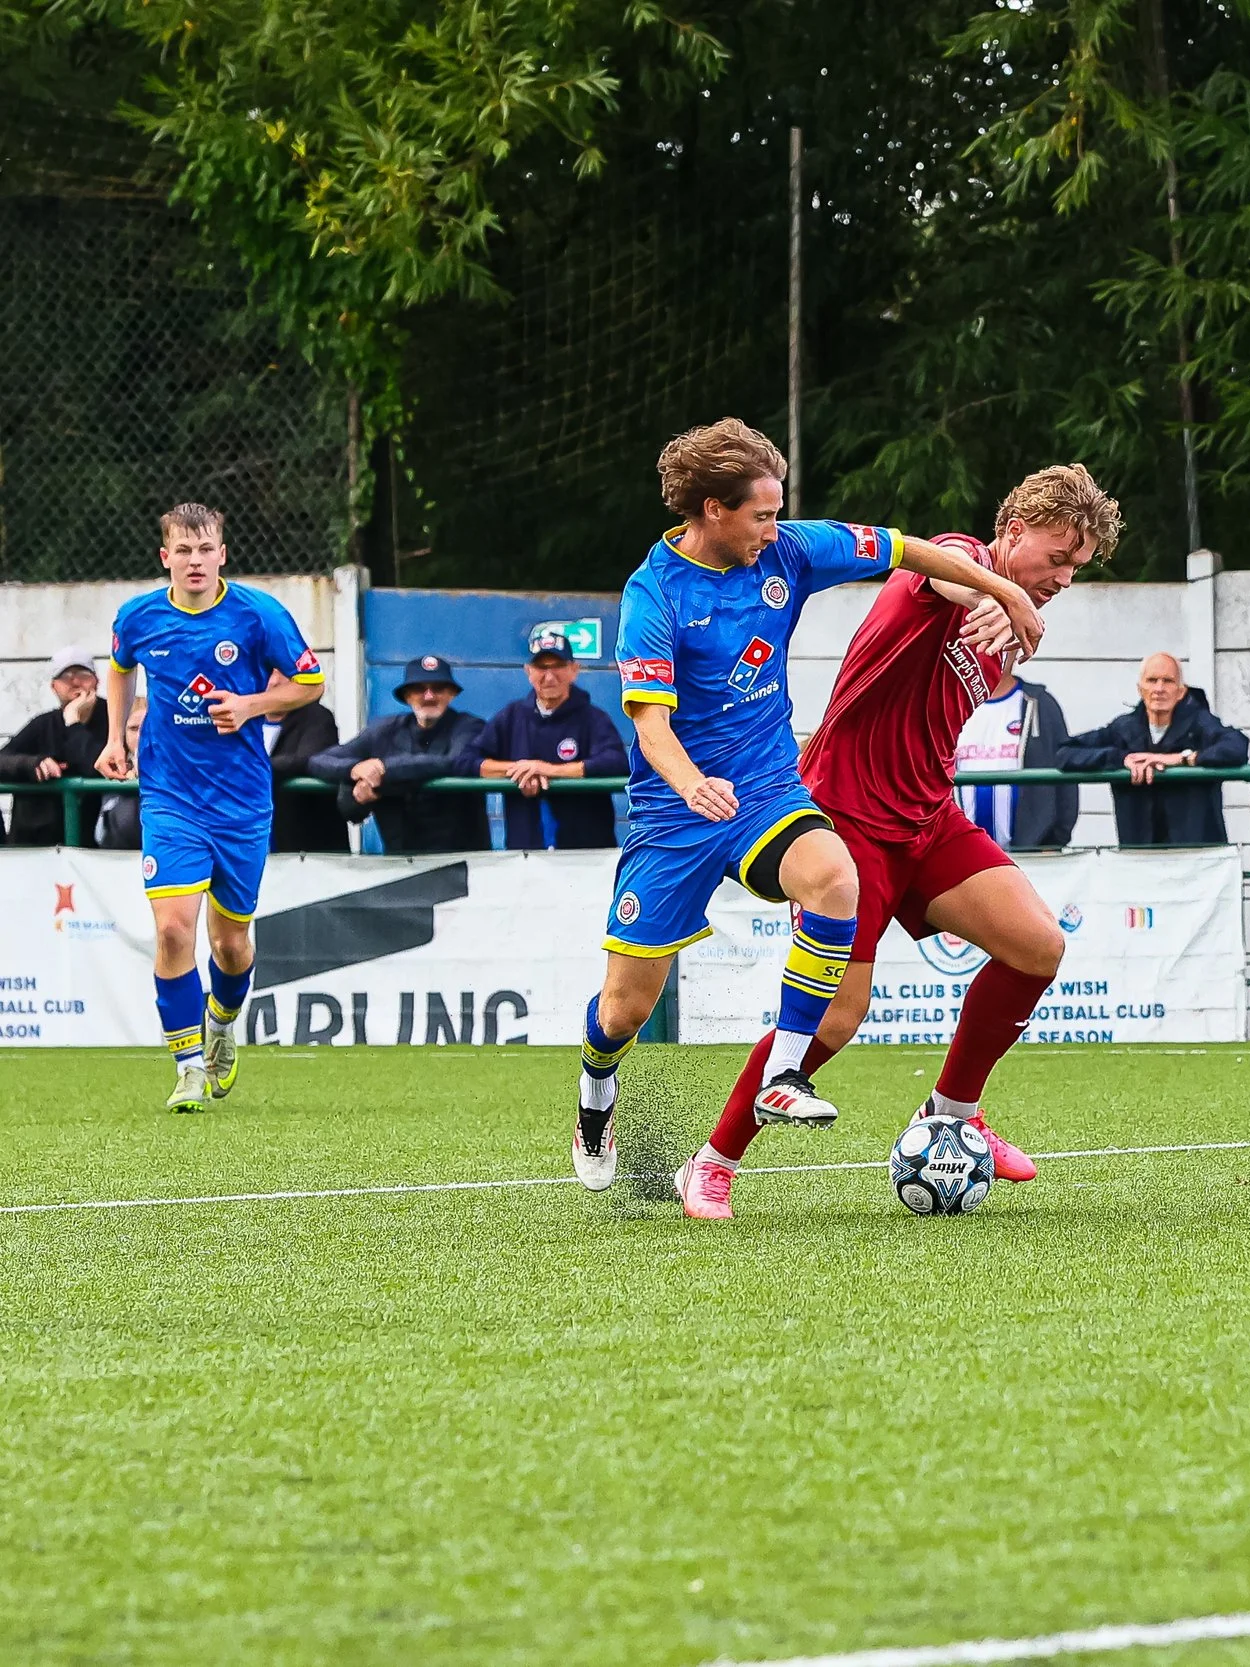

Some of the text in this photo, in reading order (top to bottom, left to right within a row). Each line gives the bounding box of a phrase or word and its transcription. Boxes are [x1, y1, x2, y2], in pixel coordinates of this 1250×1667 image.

[946, 638, 986, 706] Simply Bathr
[173, 713, 212, 725] Domin
[752, 918, 790, 936] Rota
[822, 966, 845, 978] SC
[871, 985, 893, 999] AL
[899, 984, 945, 999] CLUB
[1060, 981, 1108, 996] WISH
[44, 1000, 85, 1014] CLUB
[1030, 1003, 1165, 1020] OTBALL CLUB
[864, 1008, 945, 1023] LDFIELD
[0, 1025, 40, 1037] SON
[1038, 1031, 1113, 1043] SEASON
[859, 1033, 892, 1044] THE
[900, 1033, 943, 1044] BEST
[929, 1163, 967, 1174] Mitre
